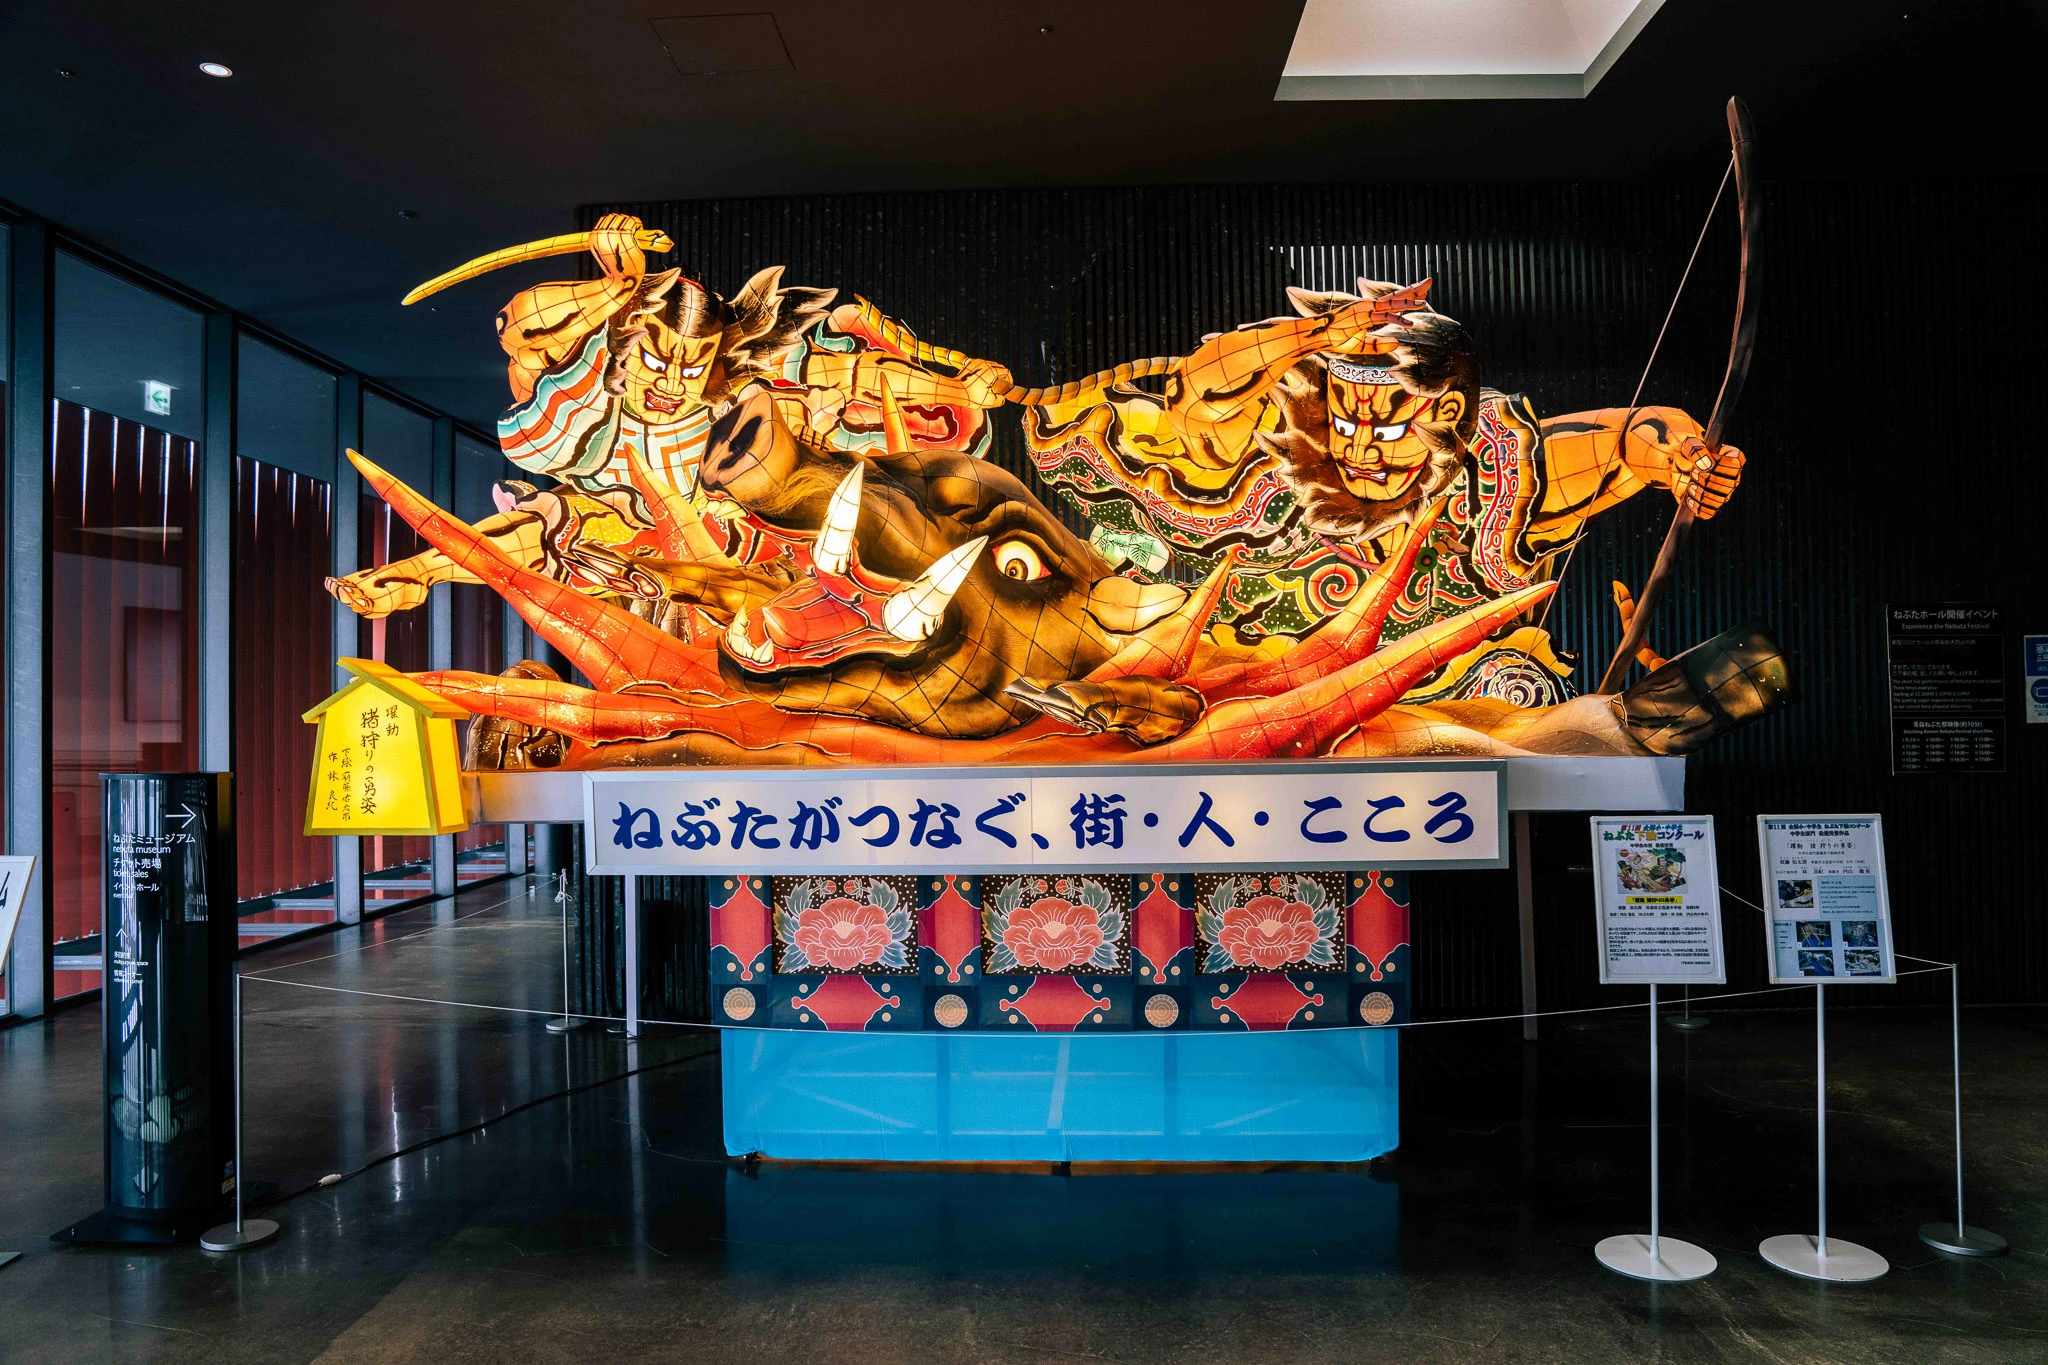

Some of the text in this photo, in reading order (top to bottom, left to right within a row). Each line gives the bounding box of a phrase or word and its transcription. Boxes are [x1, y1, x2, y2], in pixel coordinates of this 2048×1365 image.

[1893, 610, 1998, 619] ねぶたホール開催イベント
[328, 752, 338, 762] 作
[342, 748, 352, 768] 下絵
[360, 708, 380, 814] 猪狩りの勇姿
[328, 771, 339, 782] 林
[612, 791, 1473, 850] ねぶたがつなぐ、街・人・こころ
[113, 833, 196, 844] ねぶたミュージアム
[113, 858, 161, 869] チケット売場
[132, 869, 148, 878] sales
[114, 883, 159, 891] イベントホール
